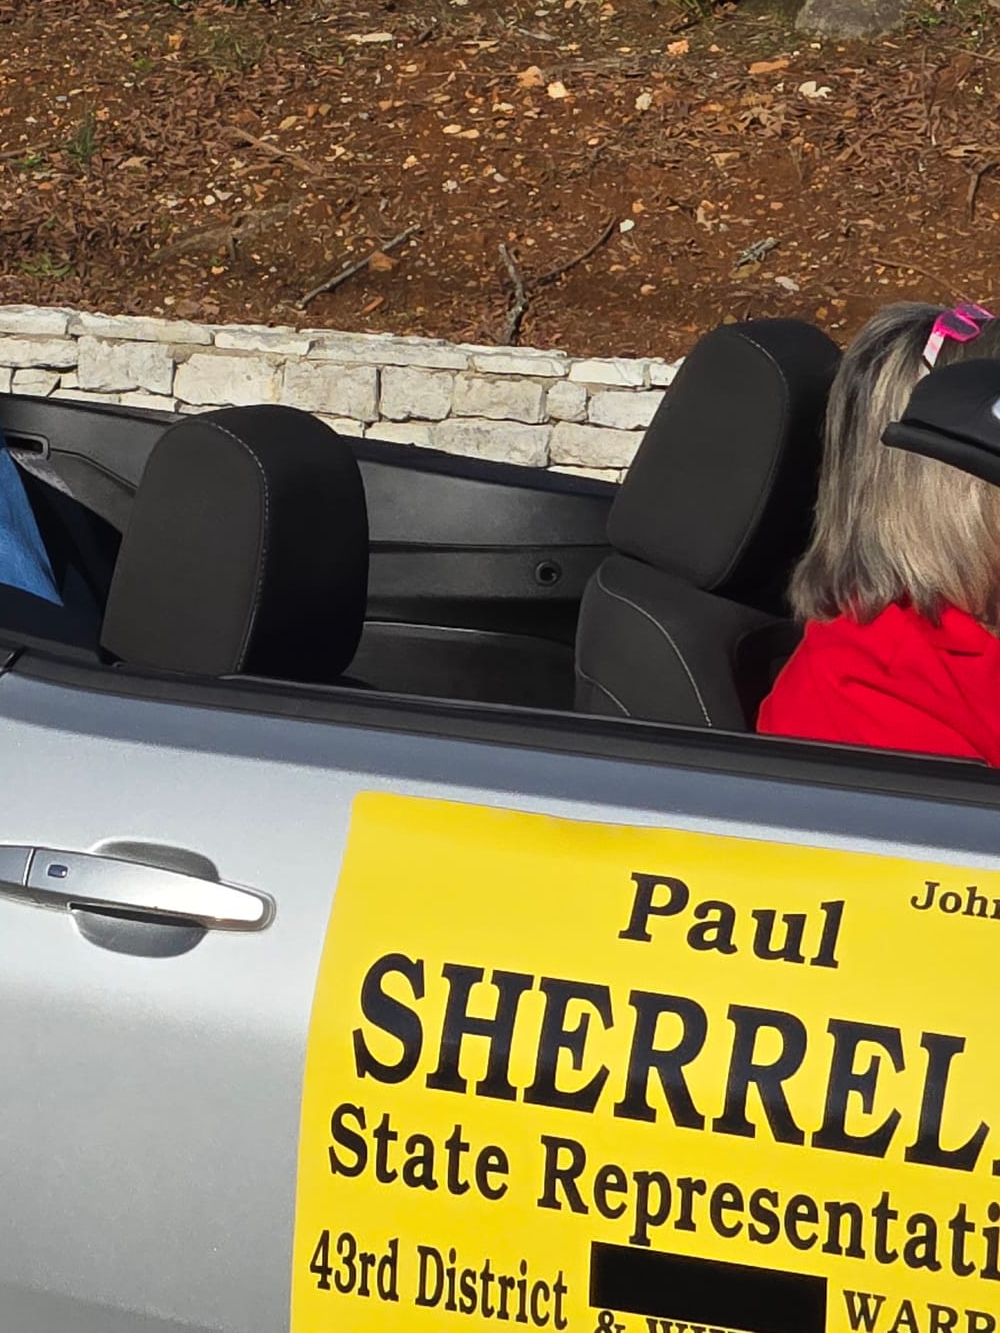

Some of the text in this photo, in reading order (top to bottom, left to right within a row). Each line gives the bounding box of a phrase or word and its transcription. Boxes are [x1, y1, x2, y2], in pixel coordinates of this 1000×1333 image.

[618, 872, 845, 969] Paul
[352, 953, 1000, 1177] SHERREL
[328, 1102, 1000, 1282] State Representati
[309, 1229, 568, 1331] 43rd District
